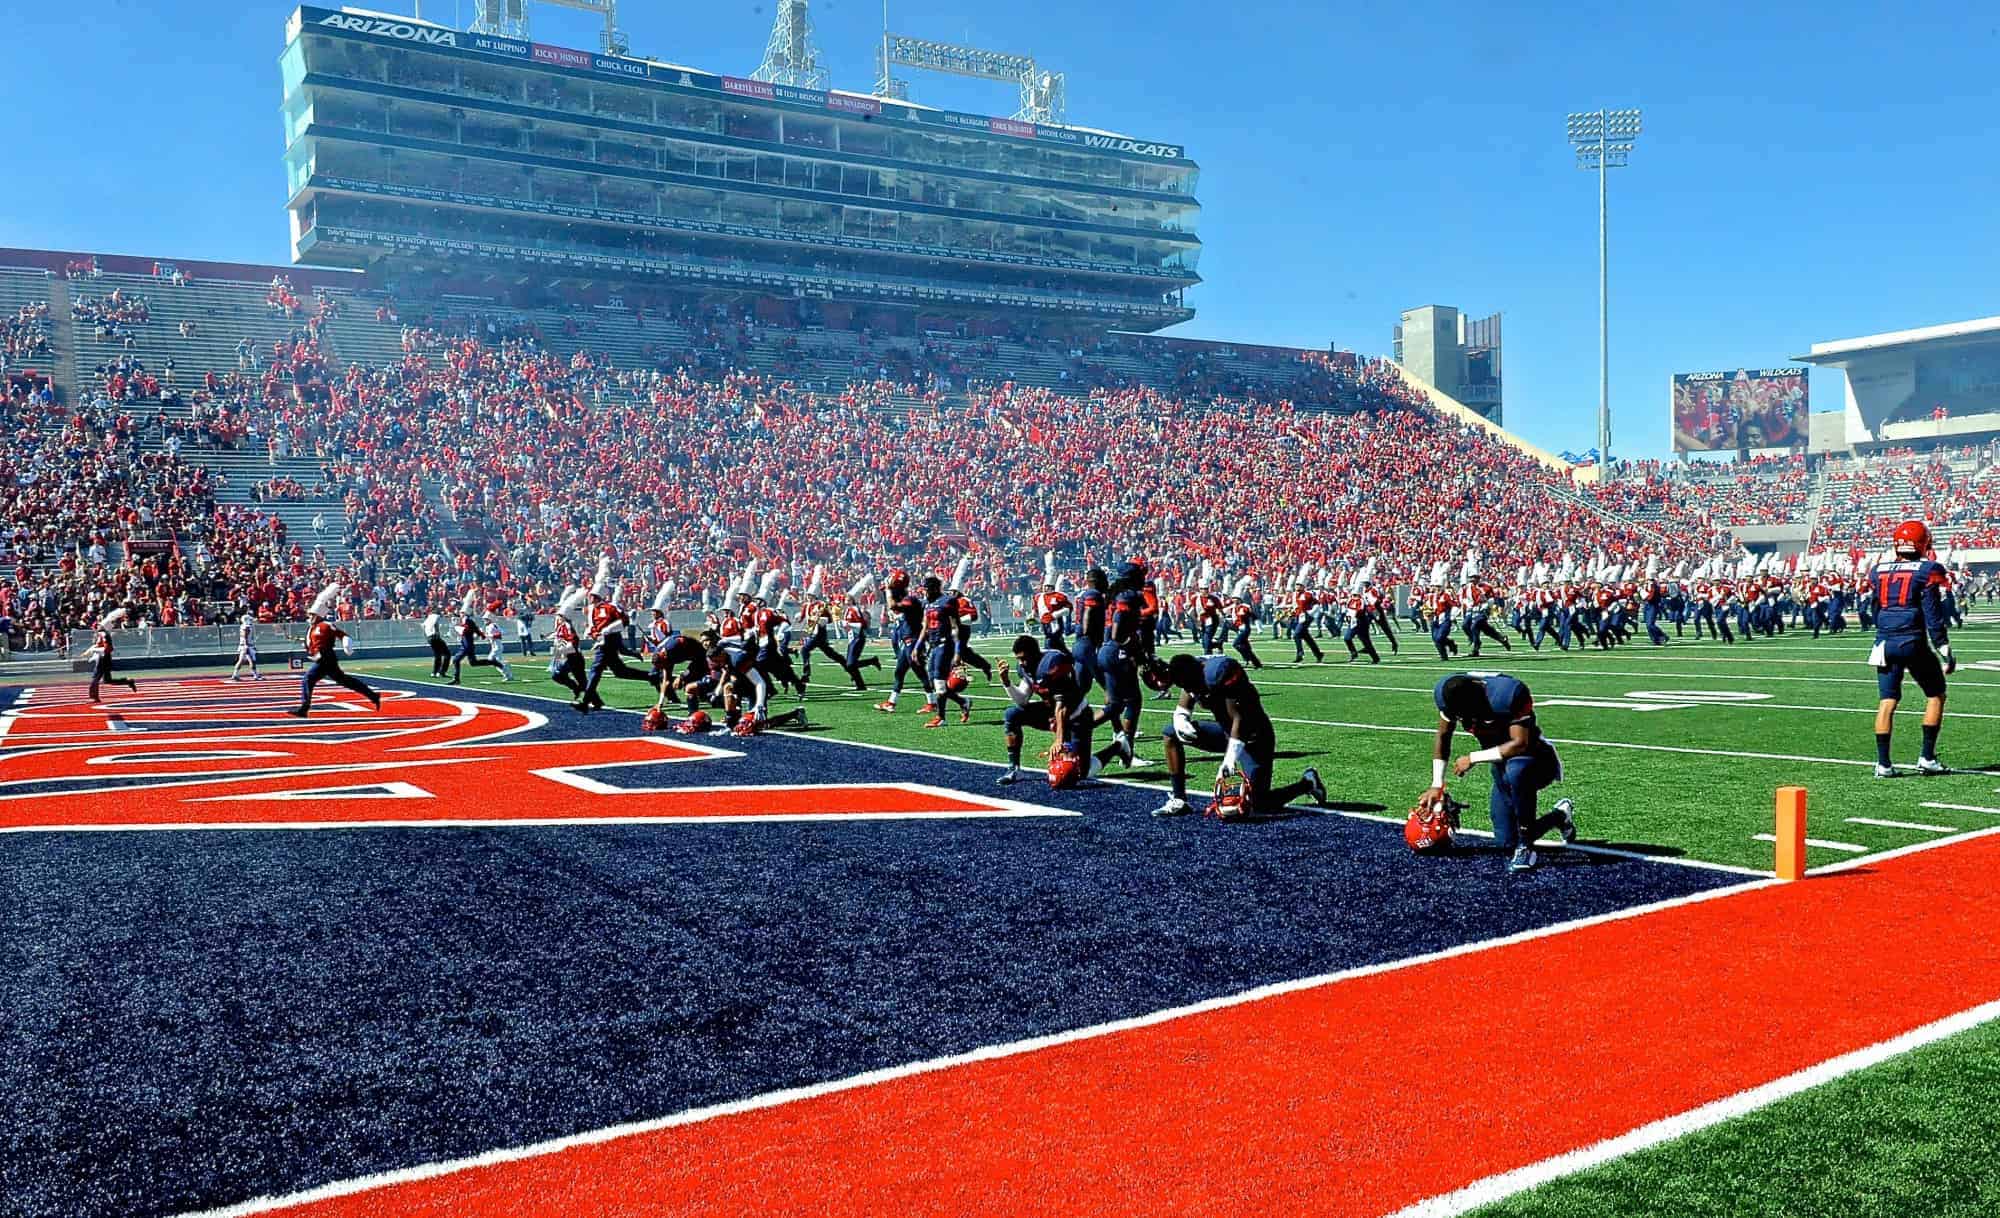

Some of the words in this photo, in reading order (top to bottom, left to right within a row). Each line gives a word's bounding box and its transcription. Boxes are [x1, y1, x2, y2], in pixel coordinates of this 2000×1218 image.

[319, 14, 457, 47] ARIZONA
[475, 39, 490, 49] ART
[595, 58, 622, 71] CHUCK
[1083, 135, 1180, 159] WILDCATS
[1686, 372, 1725, 381] ARIZONA
[1759, 367, 1802, 377] WILDCATS
[1878, 571, 1914, 609] 17
